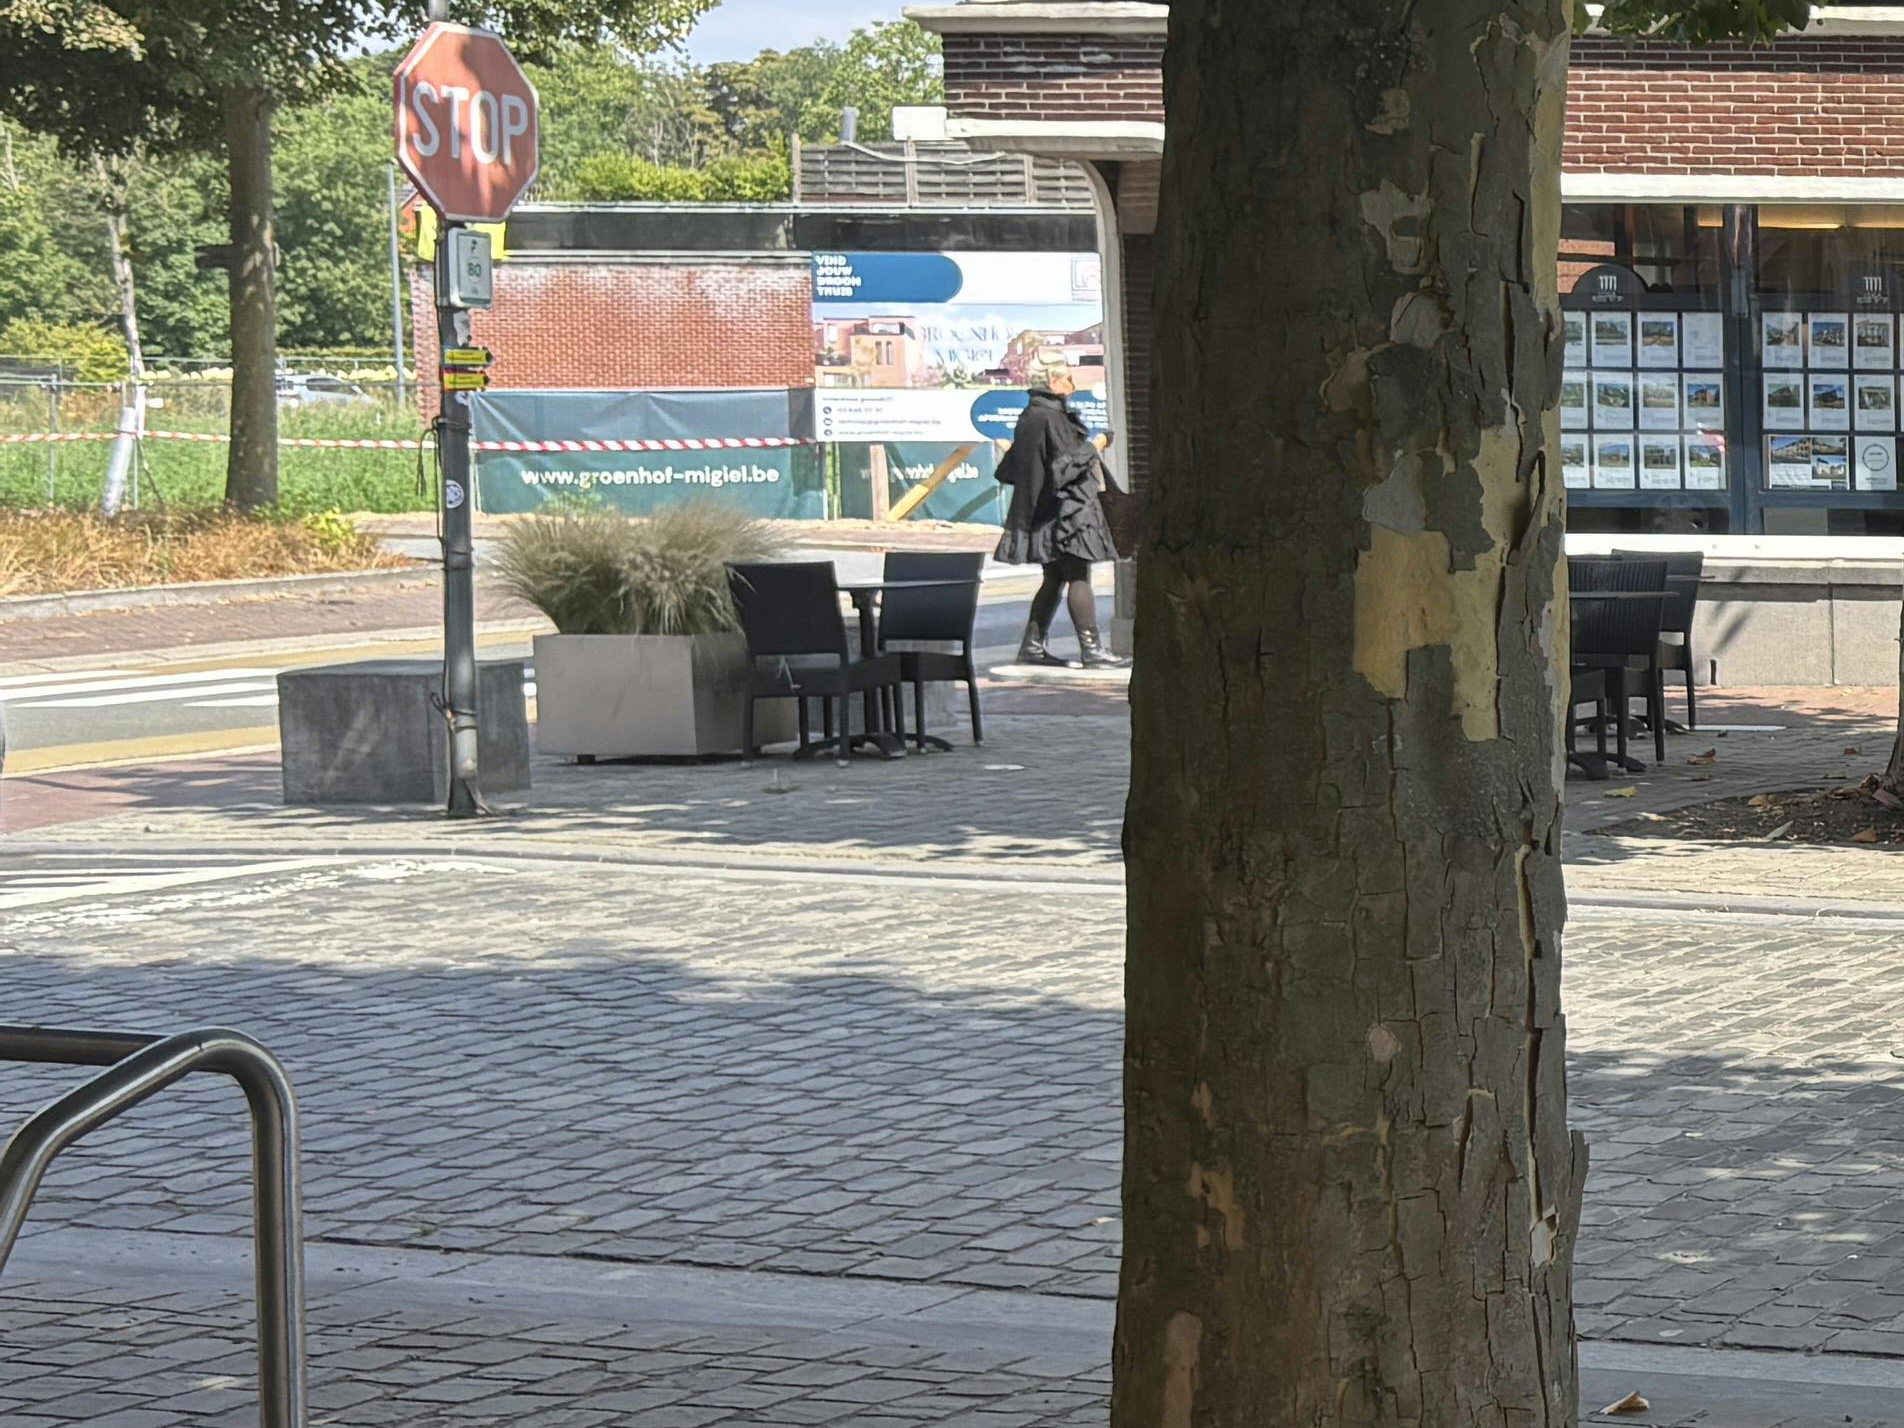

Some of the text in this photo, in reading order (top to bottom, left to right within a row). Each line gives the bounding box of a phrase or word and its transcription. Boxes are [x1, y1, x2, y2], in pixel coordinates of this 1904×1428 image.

[412, 80, 529, 167] STOP
[814, 254, 847, 266] VIND
[816, 276, 862, 287] DROOM
[816, 286, 853, 297] THUIS
[520, 465, 780, 487] www.groenhof-migiel.be
